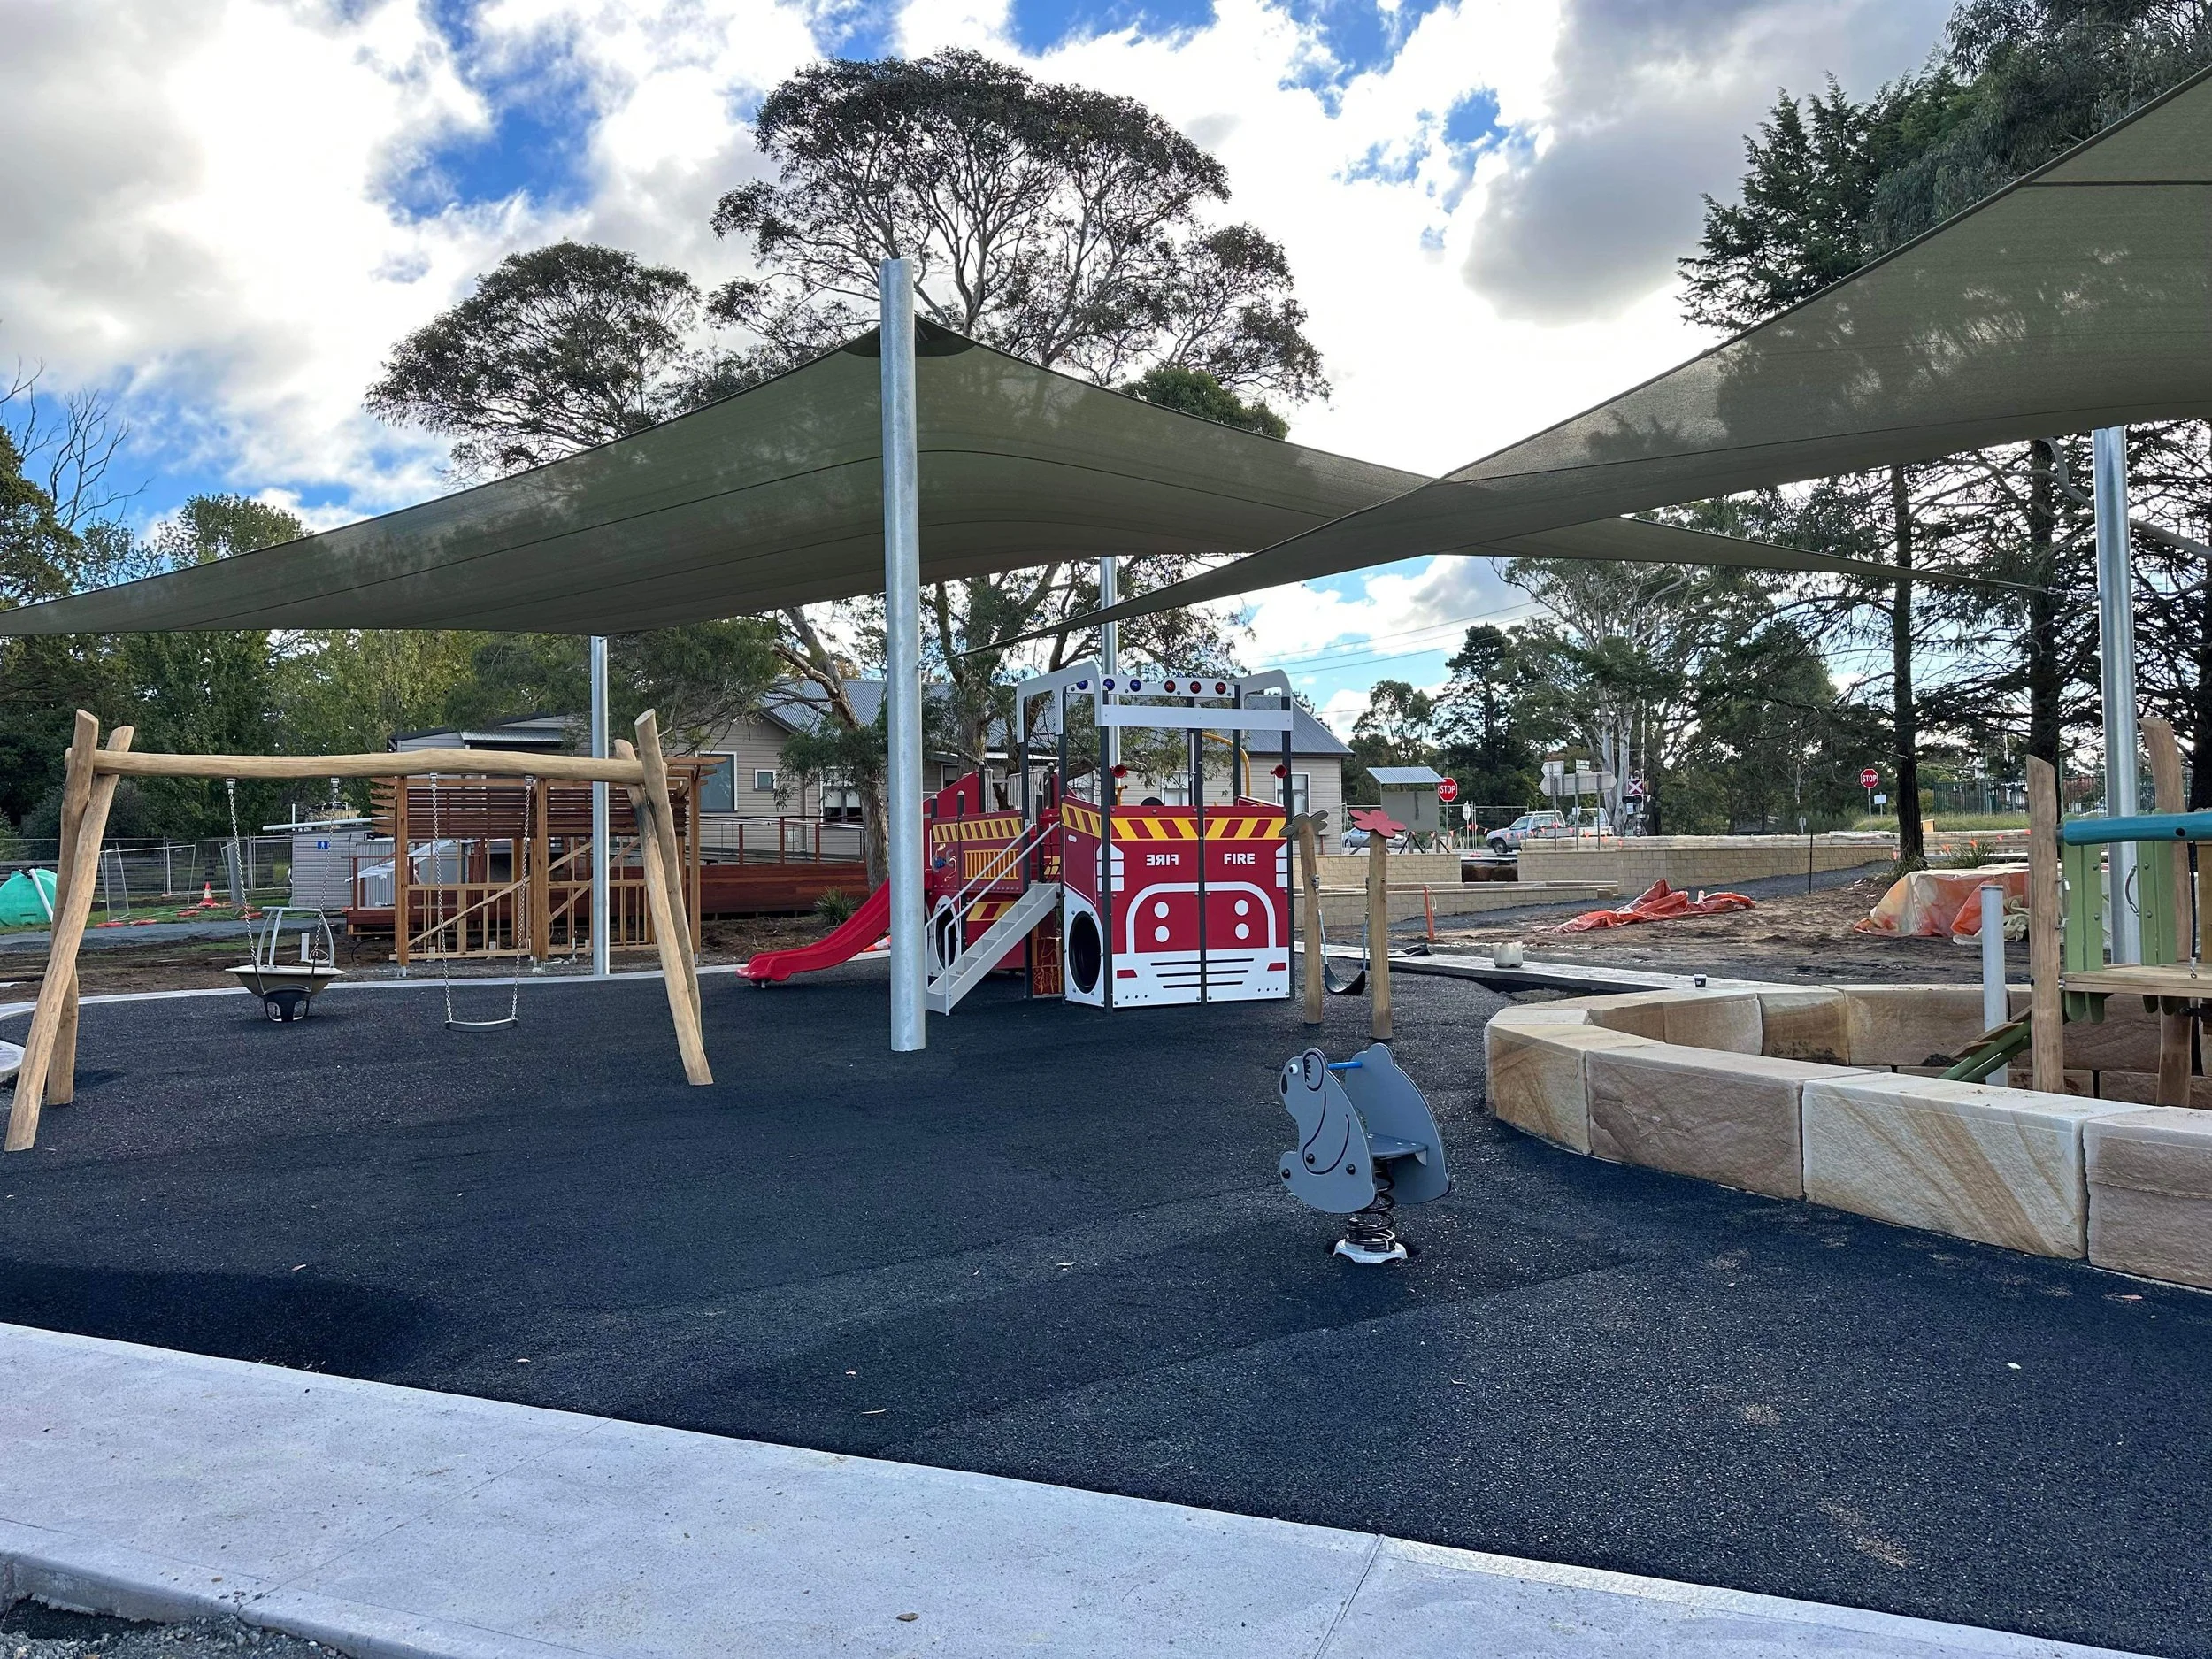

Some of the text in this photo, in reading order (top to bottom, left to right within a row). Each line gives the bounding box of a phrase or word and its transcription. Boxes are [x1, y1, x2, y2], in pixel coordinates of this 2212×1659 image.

[1862, 774, 1877, 783] STOP
[1440, 785, 1456, 794] STOP
[1224, 853, 1256, 864] FIRE
